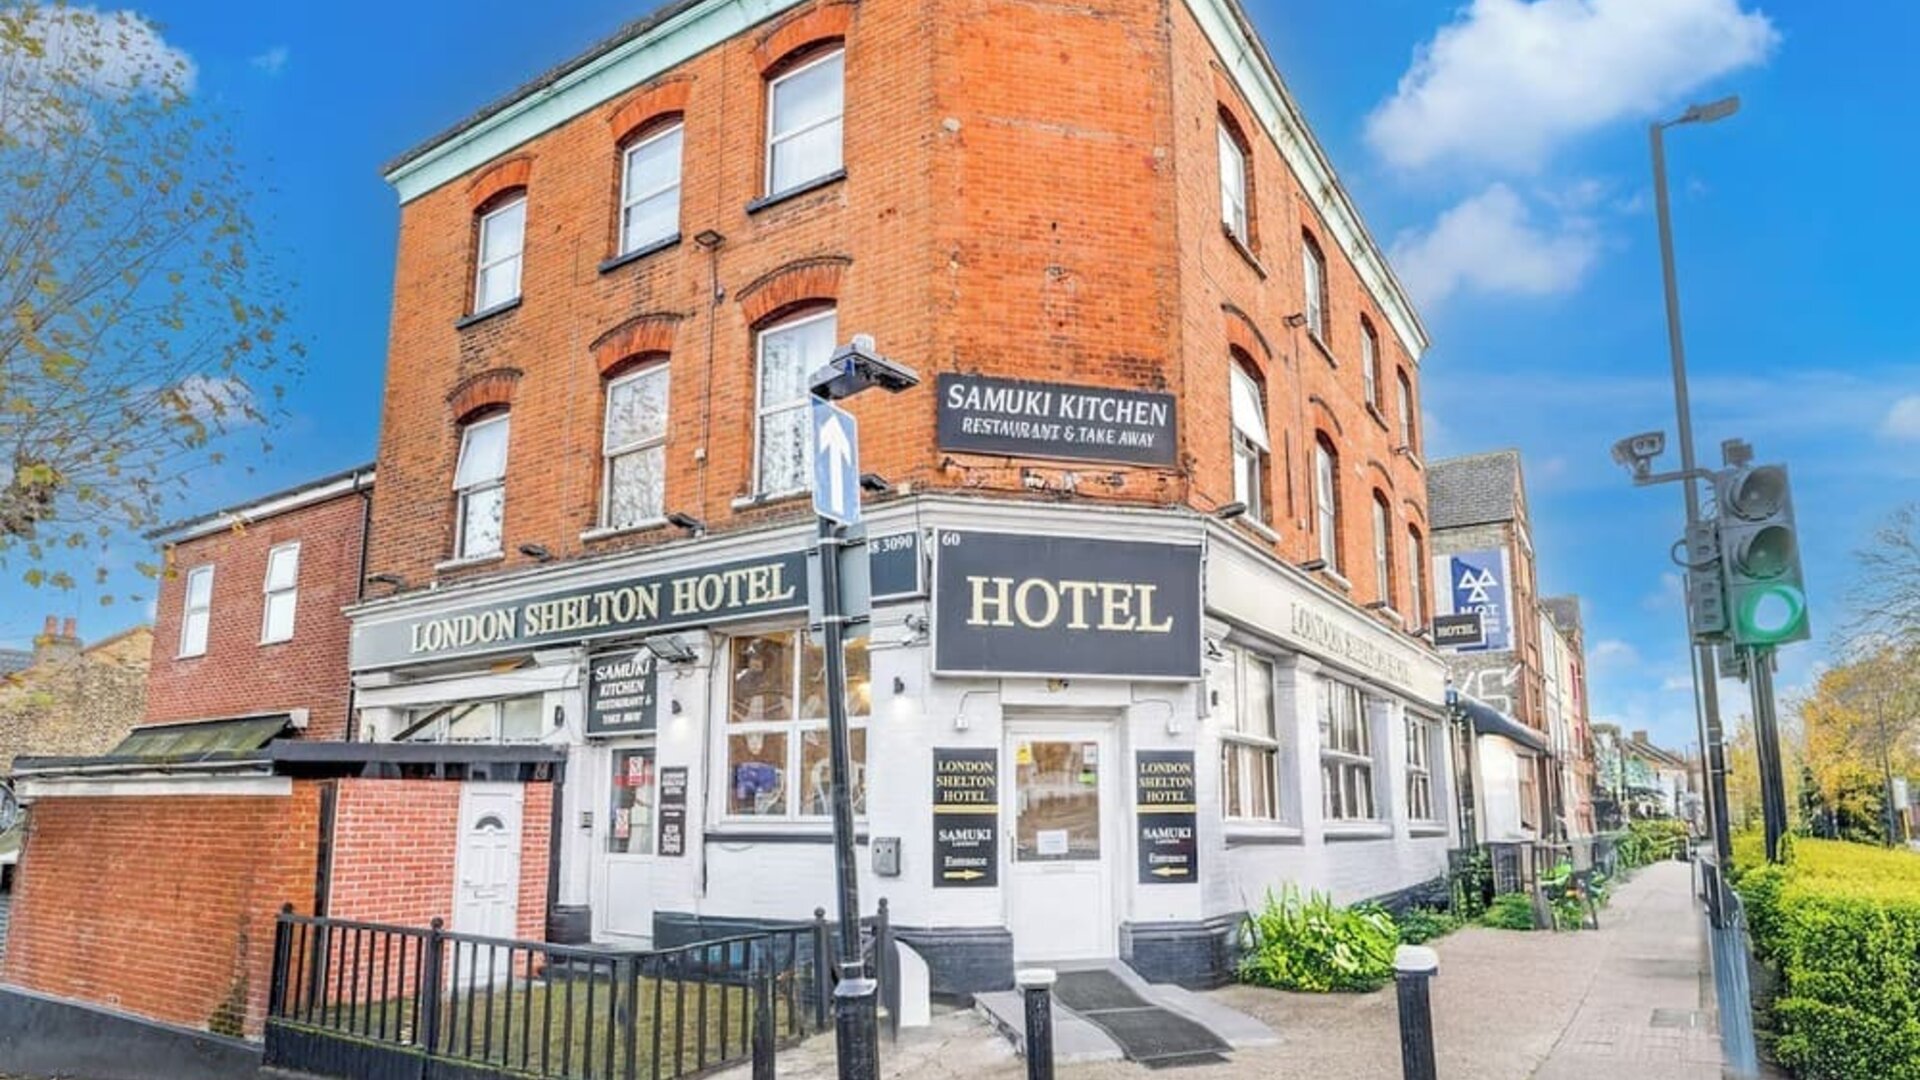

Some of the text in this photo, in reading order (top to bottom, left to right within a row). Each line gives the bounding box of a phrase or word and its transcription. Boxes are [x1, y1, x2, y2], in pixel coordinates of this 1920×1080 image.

[947, 383, 1168, 427] SAMUKI KITCHEN
[962, 417, 1155, 448] RESTAURANT & TAKE AWAY
[882, 534, 913, 552] 3090
[942, 532, 961, 546] 60
[411, 562, 795, 653] LONDON SHELTON HOTEL
[966, 576, 1174, 633] HOTEL
[1459, 603, 1499, 615] MOT
[1436, 622, 1478, 638] HOTEL
[595, 660, 650, 681] SAMUKI
[600, 678, 645, 697] KITCHEN
[938, 761, 994, 773] LONDON
[1140, 762, 1191, 774] LONDON
[936, 775, 996, 787] SHELTON
[1139, 776, 1193, 788] SHELTON
[943, 791, 989, 802] HOTEL
[1146, 790, 1187, 802] HOTEL
[938, 828, 992, 841] SAMUKI
[1142, 827, 1192, 840] SAMUKI
